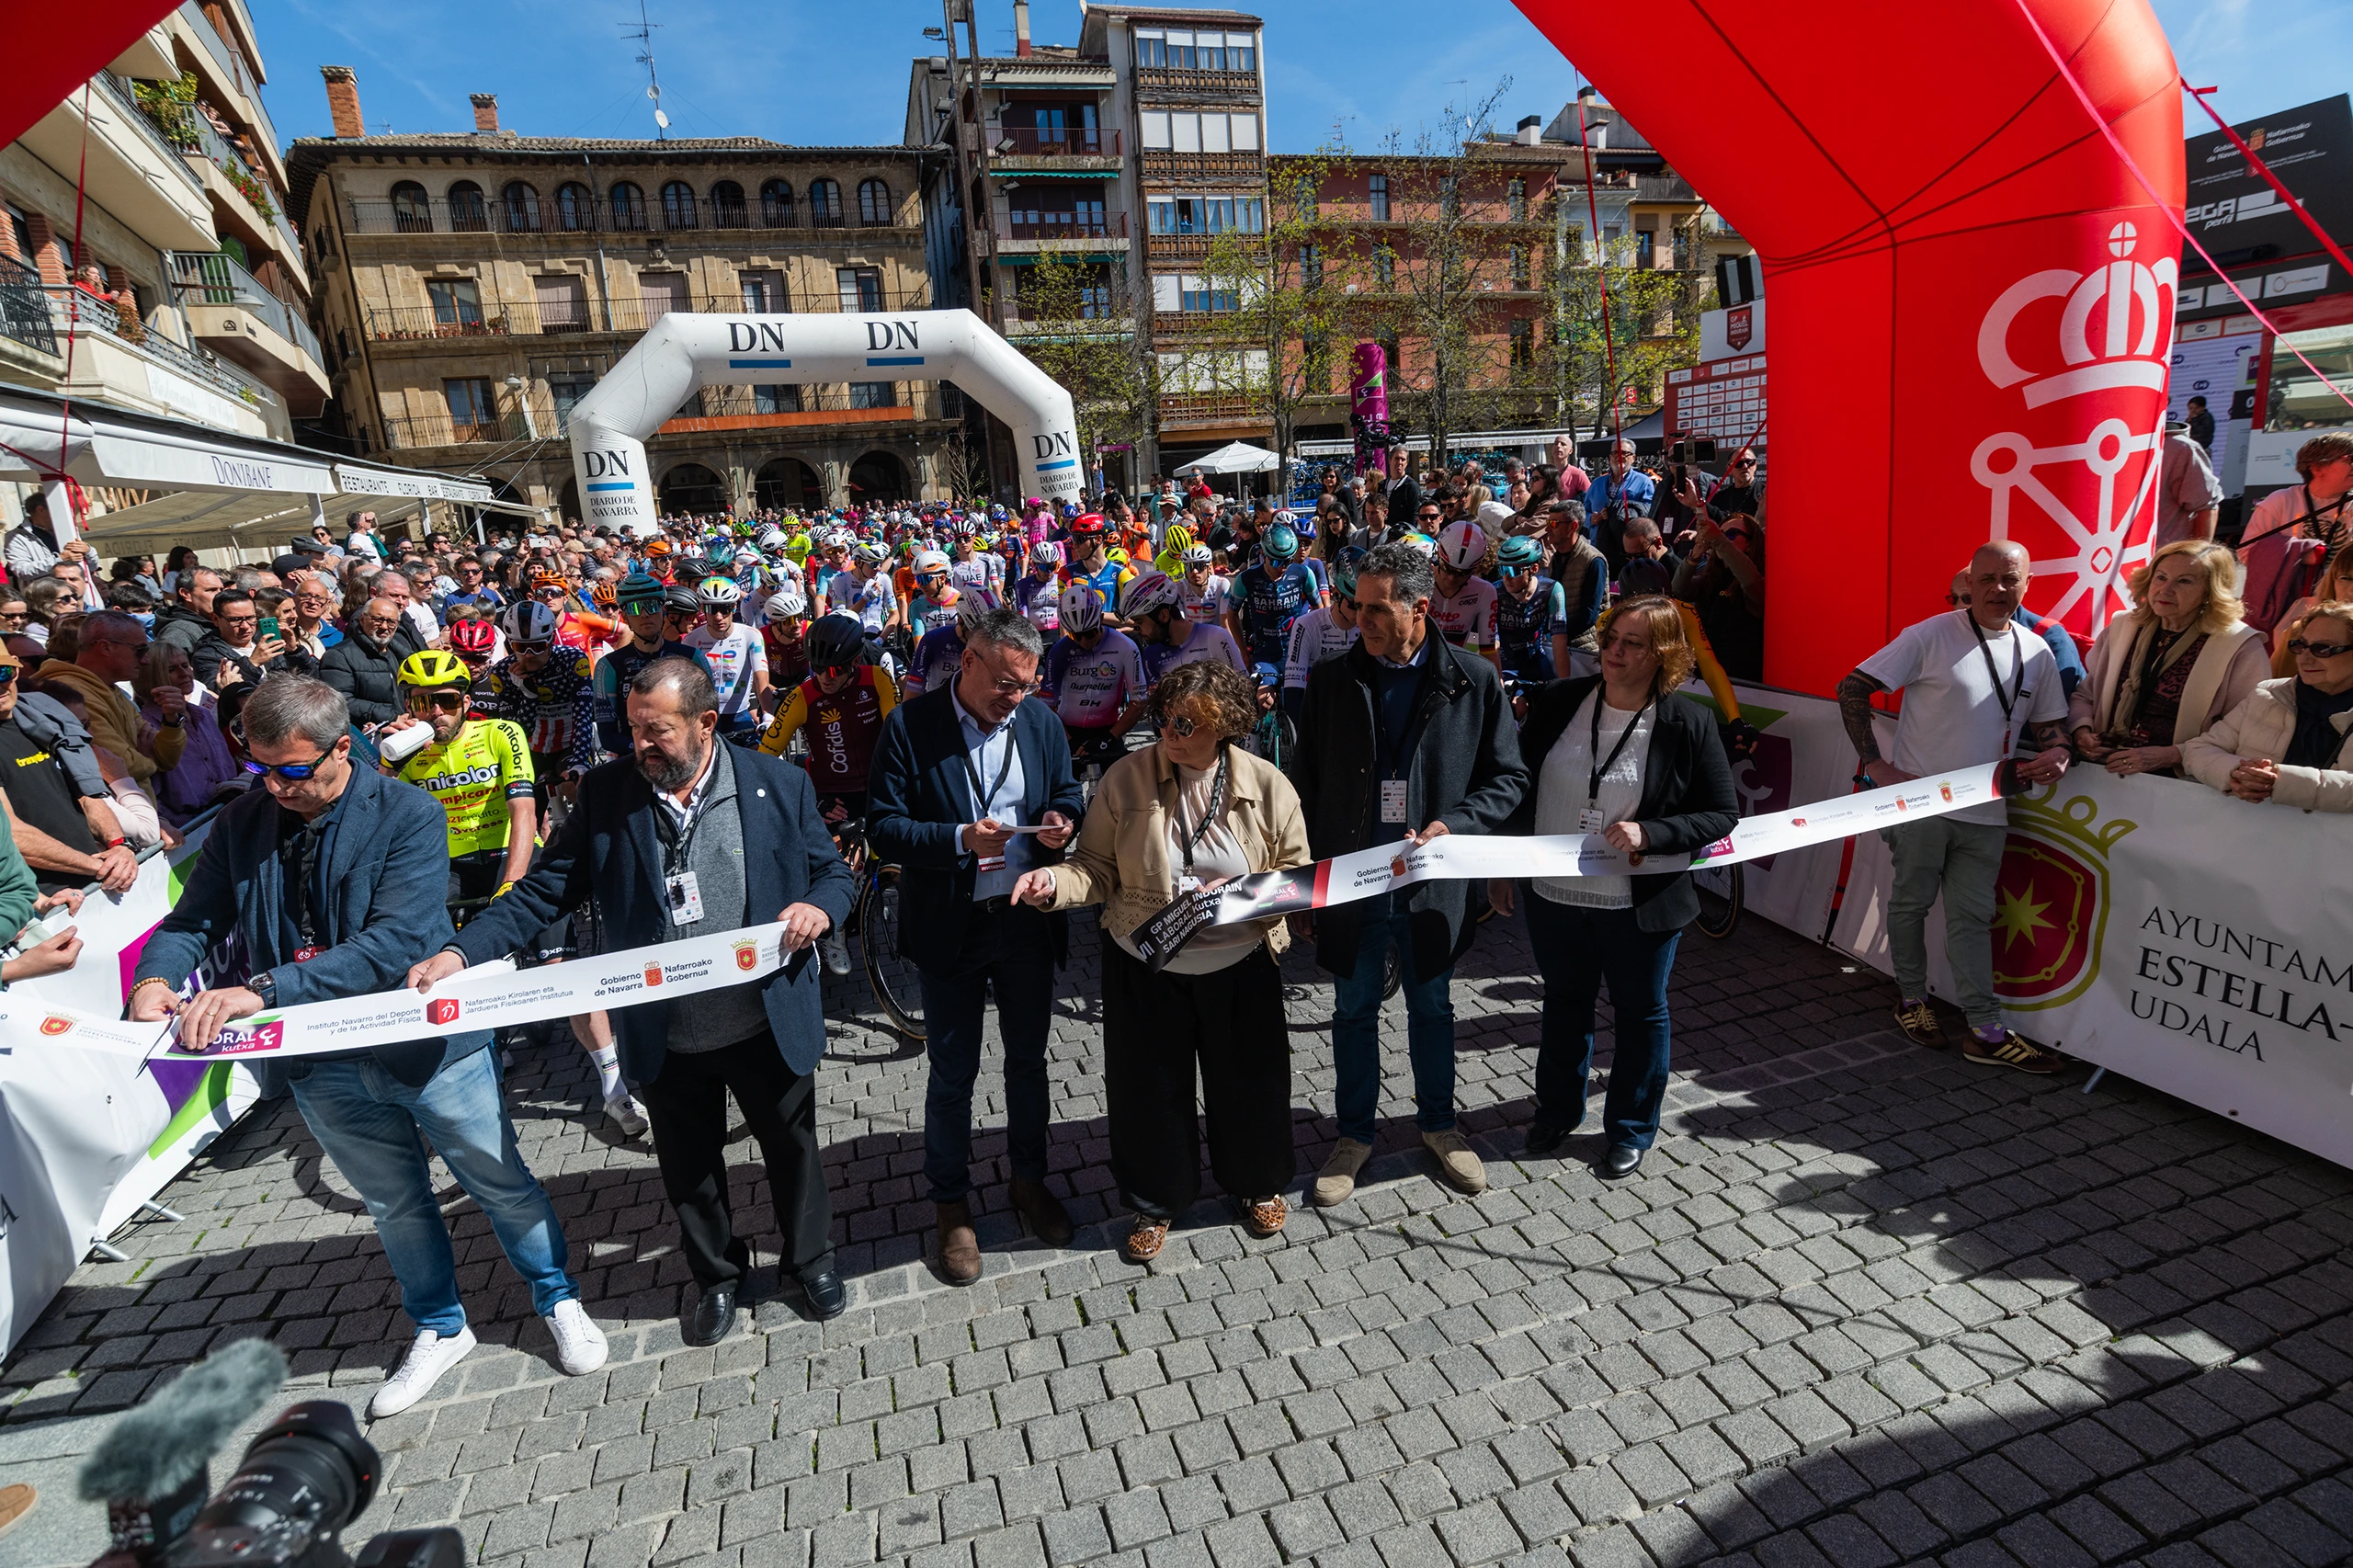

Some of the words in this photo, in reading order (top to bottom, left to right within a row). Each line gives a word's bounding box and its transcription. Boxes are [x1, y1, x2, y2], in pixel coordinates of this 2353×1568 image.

[2266, 132, 2305, 147] Gobernua
[2204, 212, 2234, 231] perfil
[726, 322, 785, 353] DN
[864, 320, 919, 350] DN
[1031, 430, 1072, 460] DN
[210, 455, 273, 488] DONIBANE
[582, 449, 630, 479] DN
[341, 475, 390, 494] RESTAURANTE
[398, 483, 422, 495] FLORIDA
[427, 484, 439, 496] BAR
[1040, 473, 1068, 484] DIARIO
[1069, 472, 1077, 480] DE
[1040, 481, 1079, 494] NAVARRA
[590, 496, 620, 506] DIARIO
[622, 495, 636, 506] DE
[592, 506, 639, 517] NAVARRA
[961, 573, 983, 582] UAE
[1254, 594, 1300, 606] BAHRAIN
[1500, 609, 1546, 624] BAHRAIN
[1290, 623, 1304, 664] Bianchi
[1070, 682, 1113, 692] Burpellet
[767, 693, 797, 739] Cofidis
[497, 722, 523, 771] anicolor
[825, 722, 849, 773] Cofidis
[416, 763, 499, 792] anicolor
[440, 784, 501, 805] mpicarn
[981, 863, 1006, 871] INVITADOS
[1357, 864, 1389, 878] Gobierno
[1353, 880, 1363, 888] de
[1364, 872, 1392, 885] Navarra
[1150, 921, 1164, 935] GP
[1165, 900, 1193, 926] MIGUEL
[1156, 911, 1193, 945] LABORAL
[1192, 895, 1222, 915] Kutxa
[1163, 937, 1181, 954] SARI
[1178, 910, 1214, 943] NAGUSIA
[2139, 905, 2353, 994] AYUNTAM
[594, 988, 606, 997] de
[608, 982, 643, 994] Navarra
[665, 969, 709, 983] Gobernua
[600, 971, 642, 986] Gobierno
[665, 958, 712, 973] Nafarroako
[464, 1002, 499, 1014] Jarduera
[500, 995, 539, 1007] Fisikoaren
[540, 989, 574, 1002] Institutua
[465, 994, 506, 1006] Nafarroako
[507, 988, 541, 999] Kirolaren
[542, 985, 555, 994] eta
[2135, 945, 2353, 1043] ESTELLA-
[307, 1020, 340, 1031] Instituto
[341, 1015, 373, 1026] Navarro
[375, 1012, 388, 1021] del
[390, 1008, 421, 1019] Deporte
[359, 1017, 396, 1029] Actividad
[398, 1015, 422, 1024] Física
[2130, 989, 2267, 1063] UDALA
[212, 1031, 256, 1045] ORAL
[222, 1041, 256, 1053] kutxa
